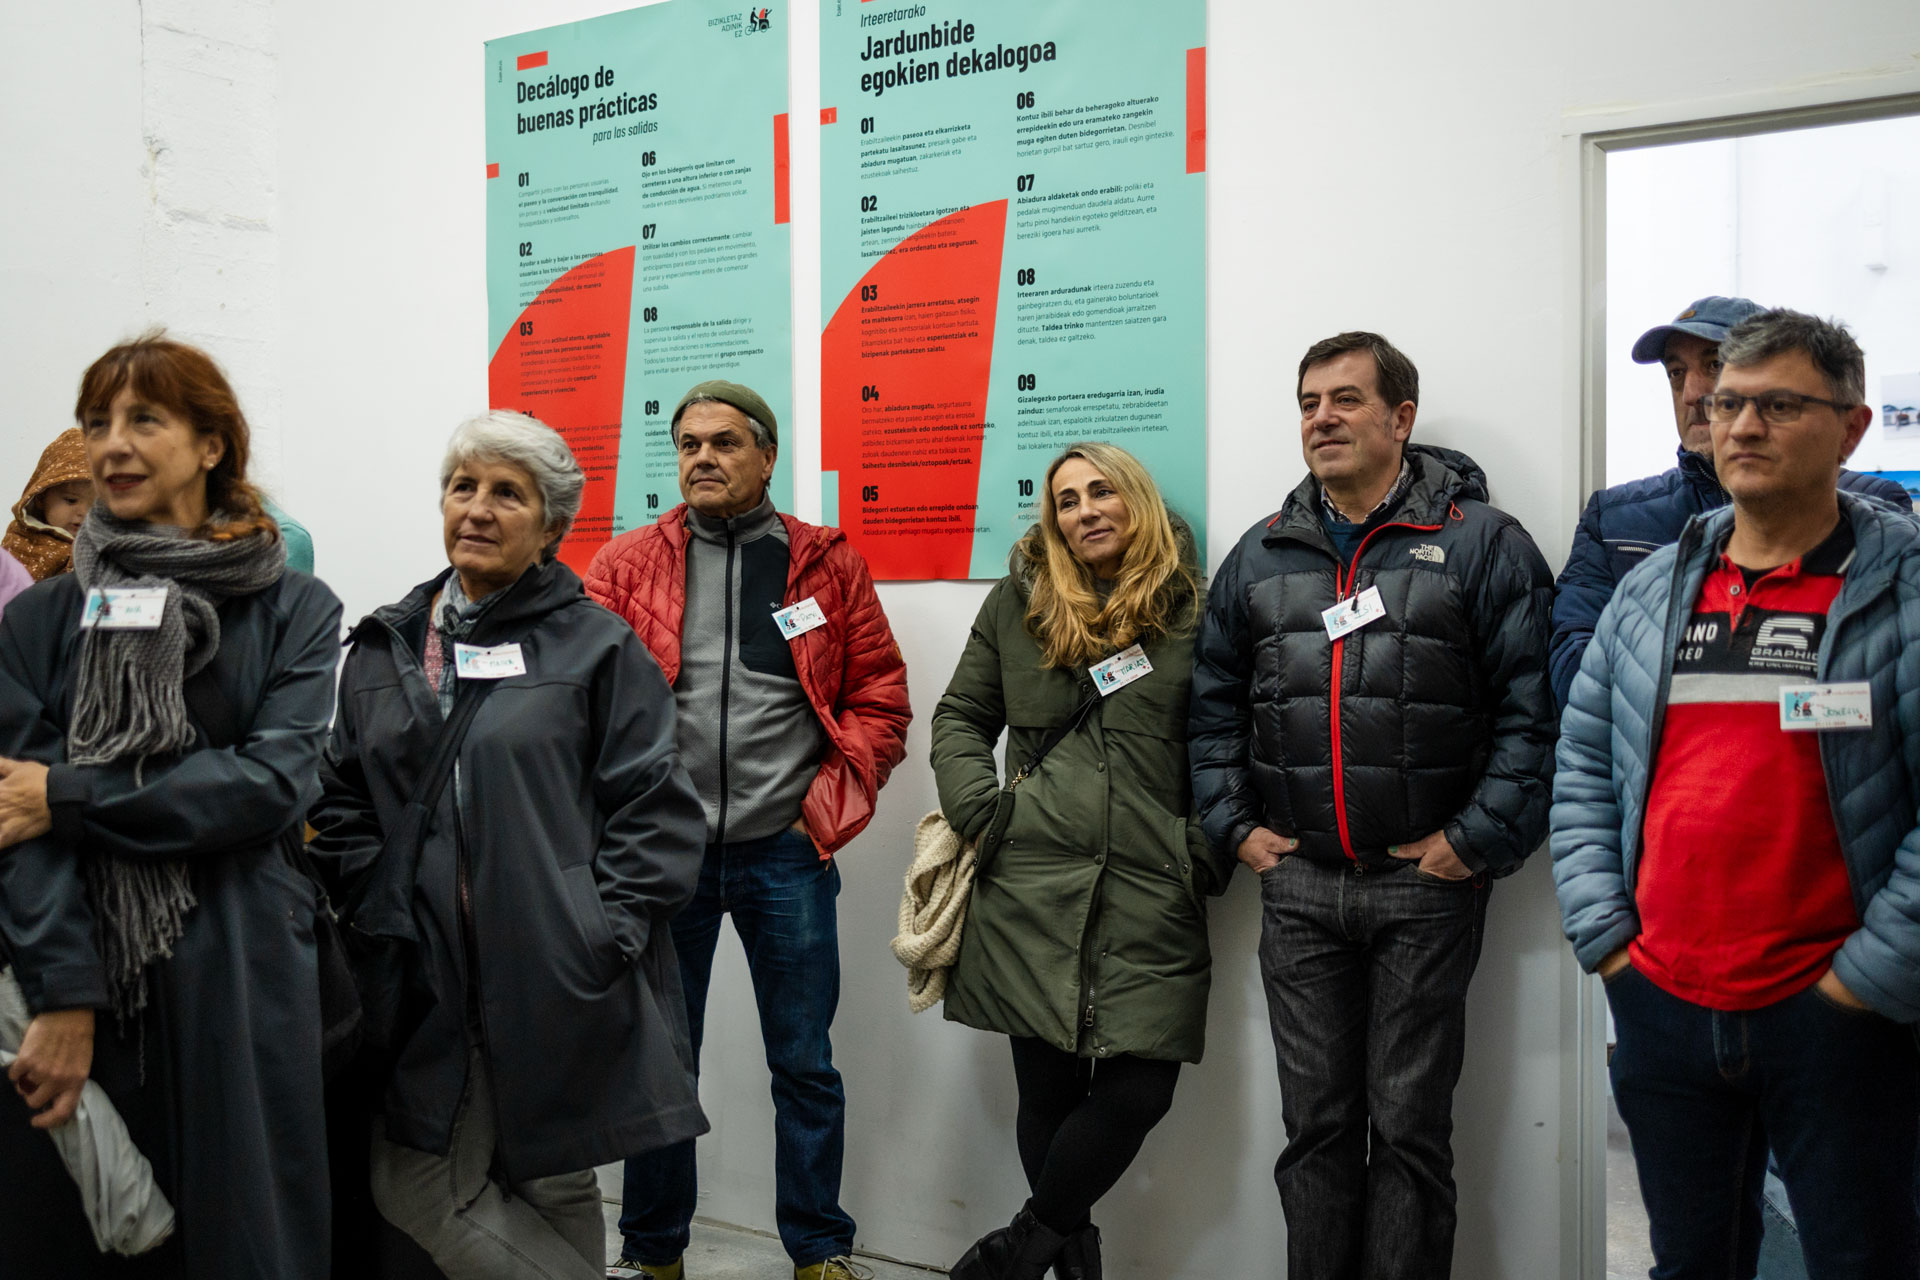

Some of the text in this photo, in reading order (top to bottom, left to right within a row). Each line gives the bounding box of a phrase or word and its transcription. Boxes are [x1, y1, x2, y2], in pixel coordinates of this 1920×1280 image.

[708, 13, 742, 27] BIZIKLETAZ
[861, 4, 926, 28] Irteeretarako
[722, 23, 742, 32] ADINIK
[735, 30, 742, 38] EZ
[861, 19, 975, 61] Jardunbide
[861, 42, 1056, 97] egokien dekalogoa
[517, 66, 614, 103] Decálogo de
[1016, 114, 1040, 122] Kontuz
[1041, 110, 1054, 118] ibili
[1085, 101, 1125, 112] beheragoko
[1127, 96, 1159, 106] altuerako
[1017, 91, 1034, 110] 06
[518, 92, 657, 134] buenas prácticas
[1017, 122, 1058, 134] errepideekin
[1059, 120, 1072, 128] edo
[1085, 114, 1121, 124] eramateko
[1122, 109, 1153, 119] zangekin
[593, 121, 658, 146] para las salidas
[861, 117, 874, 134] 01
[1017, 138, 1035, 146] muga
[1036, 135, 1057, 144] egiten
[1079, 126, 1127, 137] bidegorrietan.
[1128, 120, 1156, 130] Desnibel
[642, 151, 656, 167] 06
[519, 172, 529, 187] 01
[1017, 174, 1034, 192] 07
[1017, 196, 1046, 204] Abiadura
[1048, 191, 1079, 200] aldaketak
[1100, 186, 1123, 194] erabili:
[1124, 184, 1142, 193] poliki
[861, 195, 877, 212] 02
[861, 214, 898, 224] Erabiltzaileei
[899, 210, 935, 219] trizikloetara
[936, 207, 959, 216] igotzen
[643, 224, 656, 239] 07
[520, 242, 532, 257] 02
[1018, 268, 1035, 286] 08
[862, 285, 877, 302] 03
[1017, 290, 1049, 298] Irteeraren
[1051, 285, 1092, 295] arduradunak
[1115, 281, 1142, 289] zuzendu
[644, 307, 658, 322] 08
[520, 321, 533, 336] 03
[1018, 374, 1036, 391] 09
[862, 386, 879, 402] 04
[1018, 395, 1056, 403] Gizalegezko
[1058, 394, 1086, 402] portaera
[1087, 390, 1126, 399] eredugarria
[645, 400, 659, 416] 09
[863, 486, 878, 502] 05
[1018, 479, 1033, 496] 10
[646, 494, 658, 508] 10
[1409, 548, 1433, 556] NORTH
